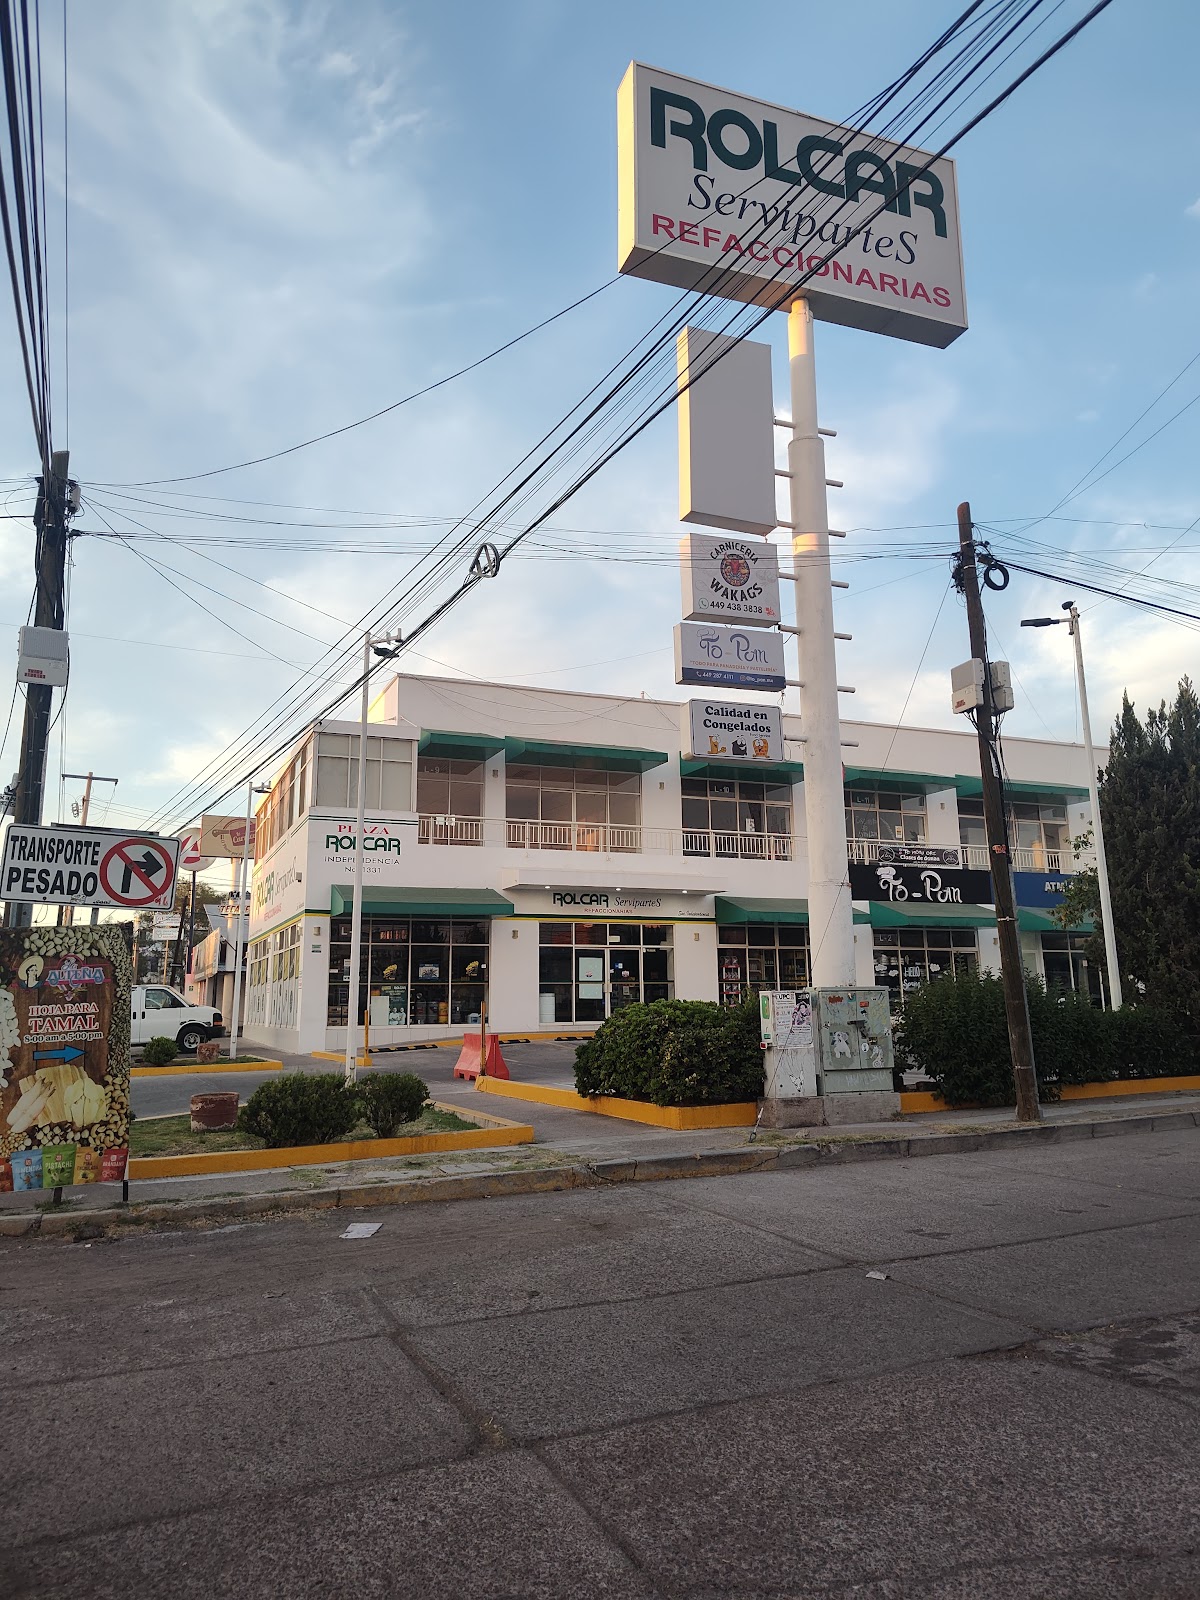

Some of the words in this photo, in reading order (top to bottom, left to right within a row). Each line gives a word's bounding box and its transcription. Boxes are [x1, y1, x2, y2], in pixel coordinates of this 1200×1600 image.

[650, 86, 947, 238] ROLCAR
[687, 173, 918, 265] ServiparteS
[652, 213, 951, 308] REFACCIONARIAS
[710, 541, 759, 565] CARNICERIA
[710, 577, 763, 602] WAKAGS
[710, 601, 725, 609] 449
[727, 602, 742, 611] 438
[743, 604, 763, 613] 3838
[705, 705, 751, 719] Calidad
[753, 711, 768, 720] en
[703, 718, 771, 733] Congelados
[11, 835, 101, 866] TRANSPORTE
[324, 856, 400, 864] INDEPDENCIA
[6, 866, 98, 897] PESADO
[553, 893, 609, 908] ROLCAR
[29, 1005, 64, 1016] HOJA
[65, 1003, 99, 1014] PARA
[28, 1016, 99, 1034] TAMAL
[45, 1033, 59, 1042] am
[88, 1031, 103, 1042] pm
